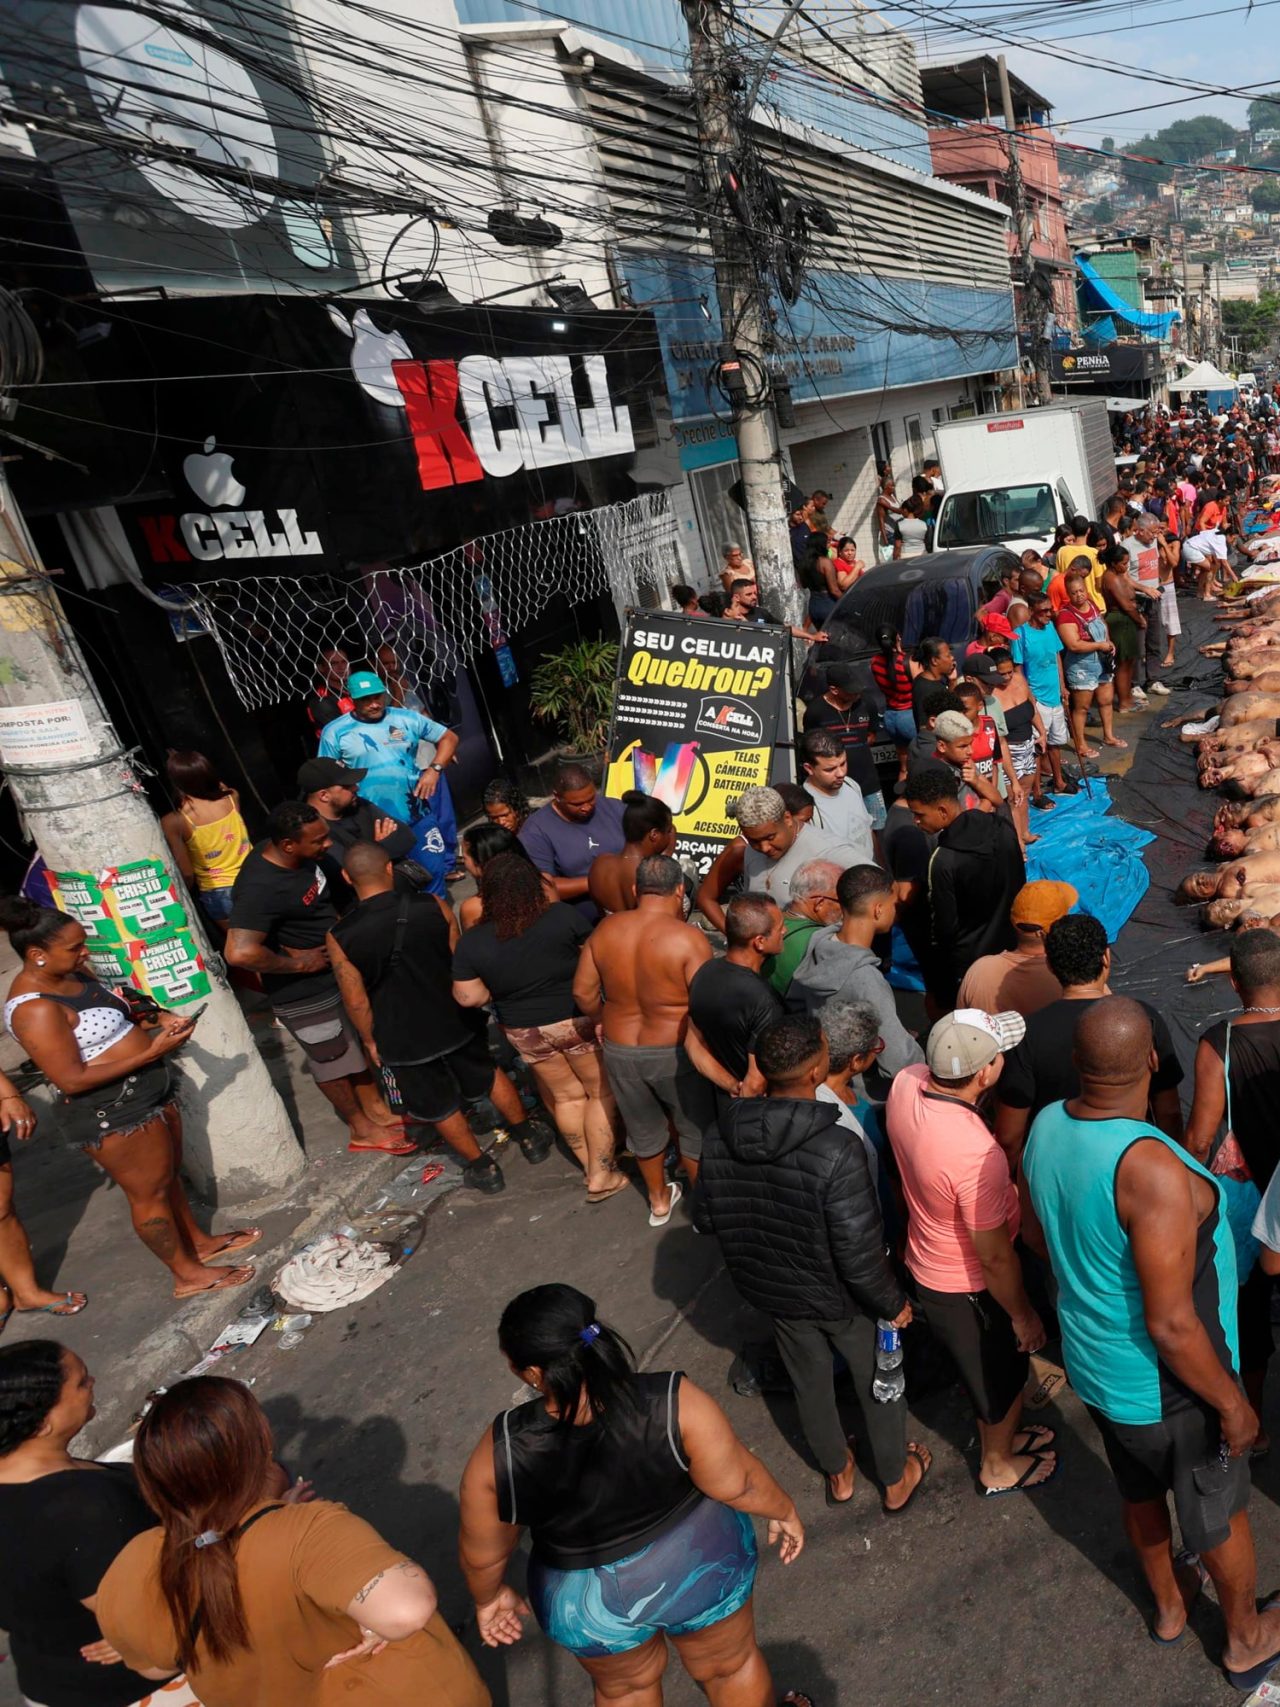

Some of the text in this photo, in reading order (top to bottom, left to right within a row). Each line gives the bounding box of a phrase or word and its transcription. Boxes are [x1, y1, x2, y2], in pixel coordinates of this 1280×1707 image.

[1077, 355, 1110, 366] PENHA
[138, 508, 324, 562] KCELL
[633, 630, 775, 664] SEU CELULAR
[627, 650, 773, 697] Quebrou?
[47, 715, 72, 725] POR:
[705, 706, 716, 719] A
[698, 719, 759, 739] CONSERTA NA HORA
[734, 751, 761, 764] TELAS
[715, 761, 759, 779] CÂMERAS
[725, 795, 740, 806] CA
[694, 820, 743, 836] ACESSÓRI
[118, 871, 142, 885] PENHA
[148, 867, 157, 877] DE
[114, 878, 162, 901] CRISTO
[146, 943, 169, 957] PENHA
[174, 938, 183, 948] DE
[142, 947, 188, 971] CRISTO
